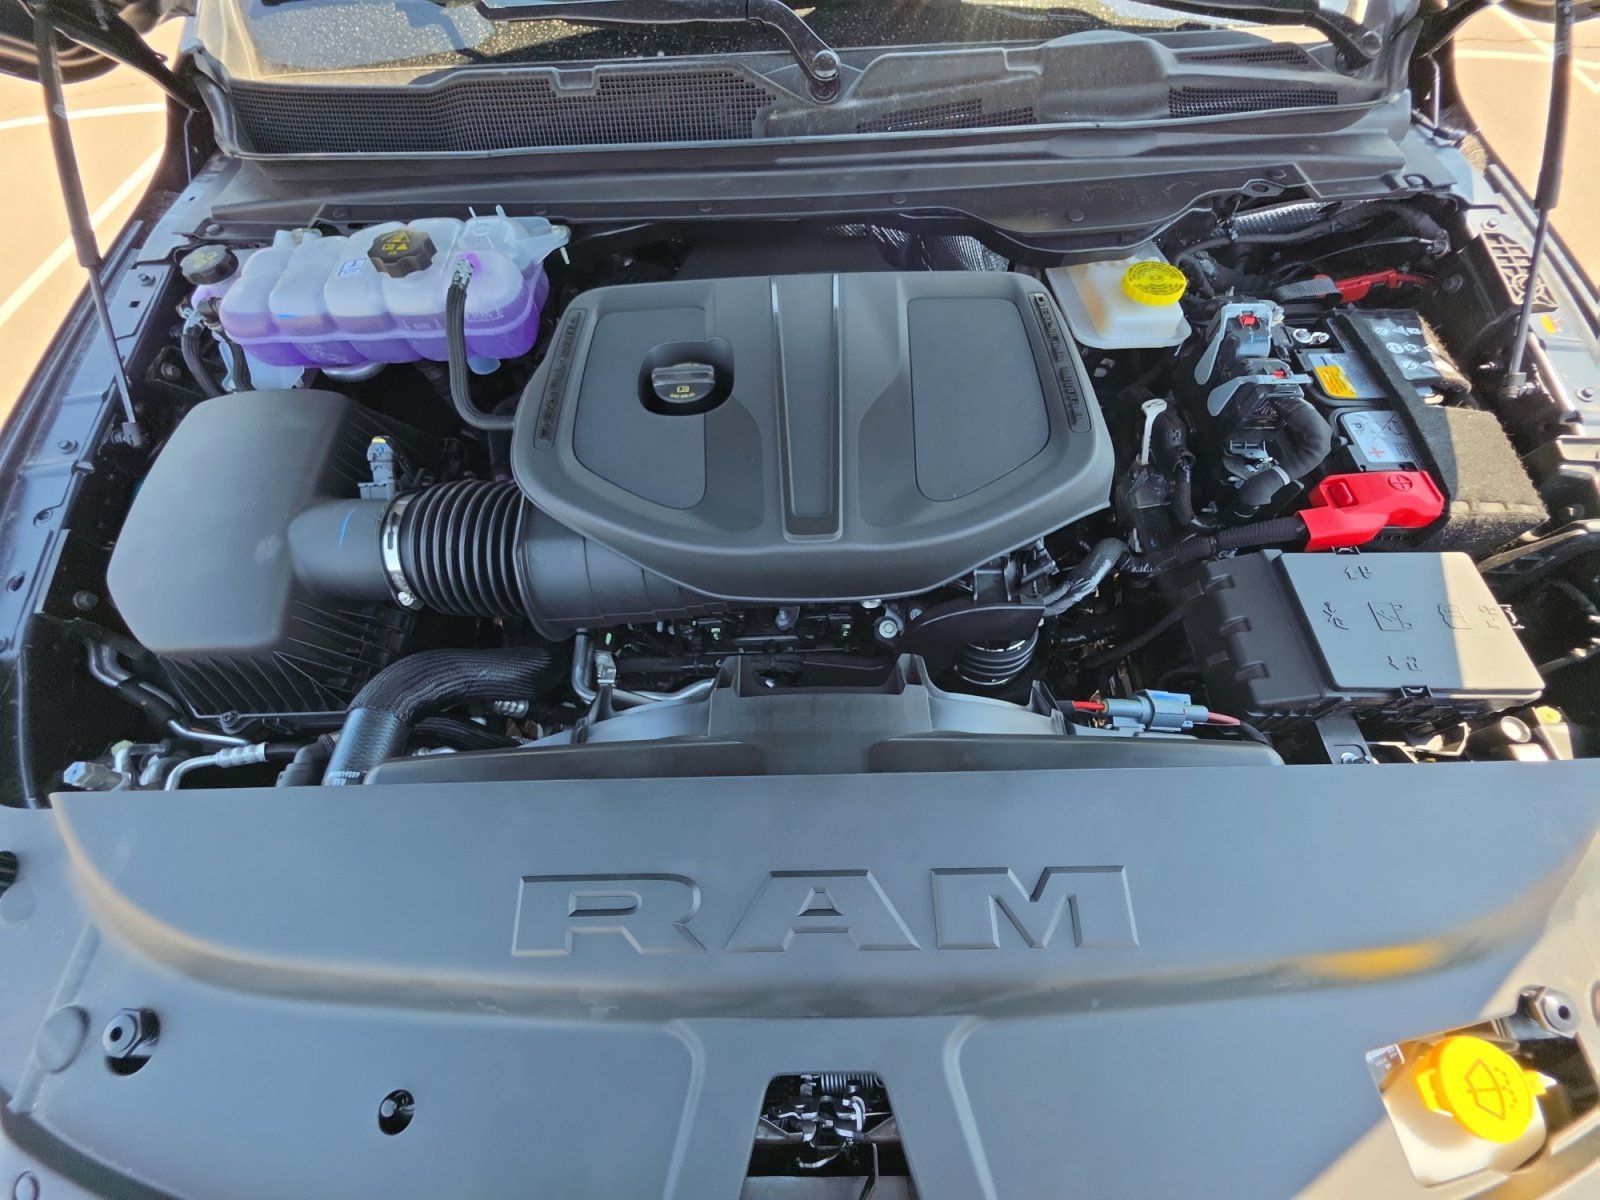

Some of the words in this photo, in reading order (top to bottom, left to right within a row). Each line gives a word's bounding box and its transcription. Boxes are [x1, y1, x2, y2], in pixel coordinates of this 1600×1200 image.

[1034, 292, 1065, 363] TURBO
[539, 362, 568, 441] TURBO
[1059, 366, 1083, 426] TWIN
[511, 865, 1140, 957] RAM
